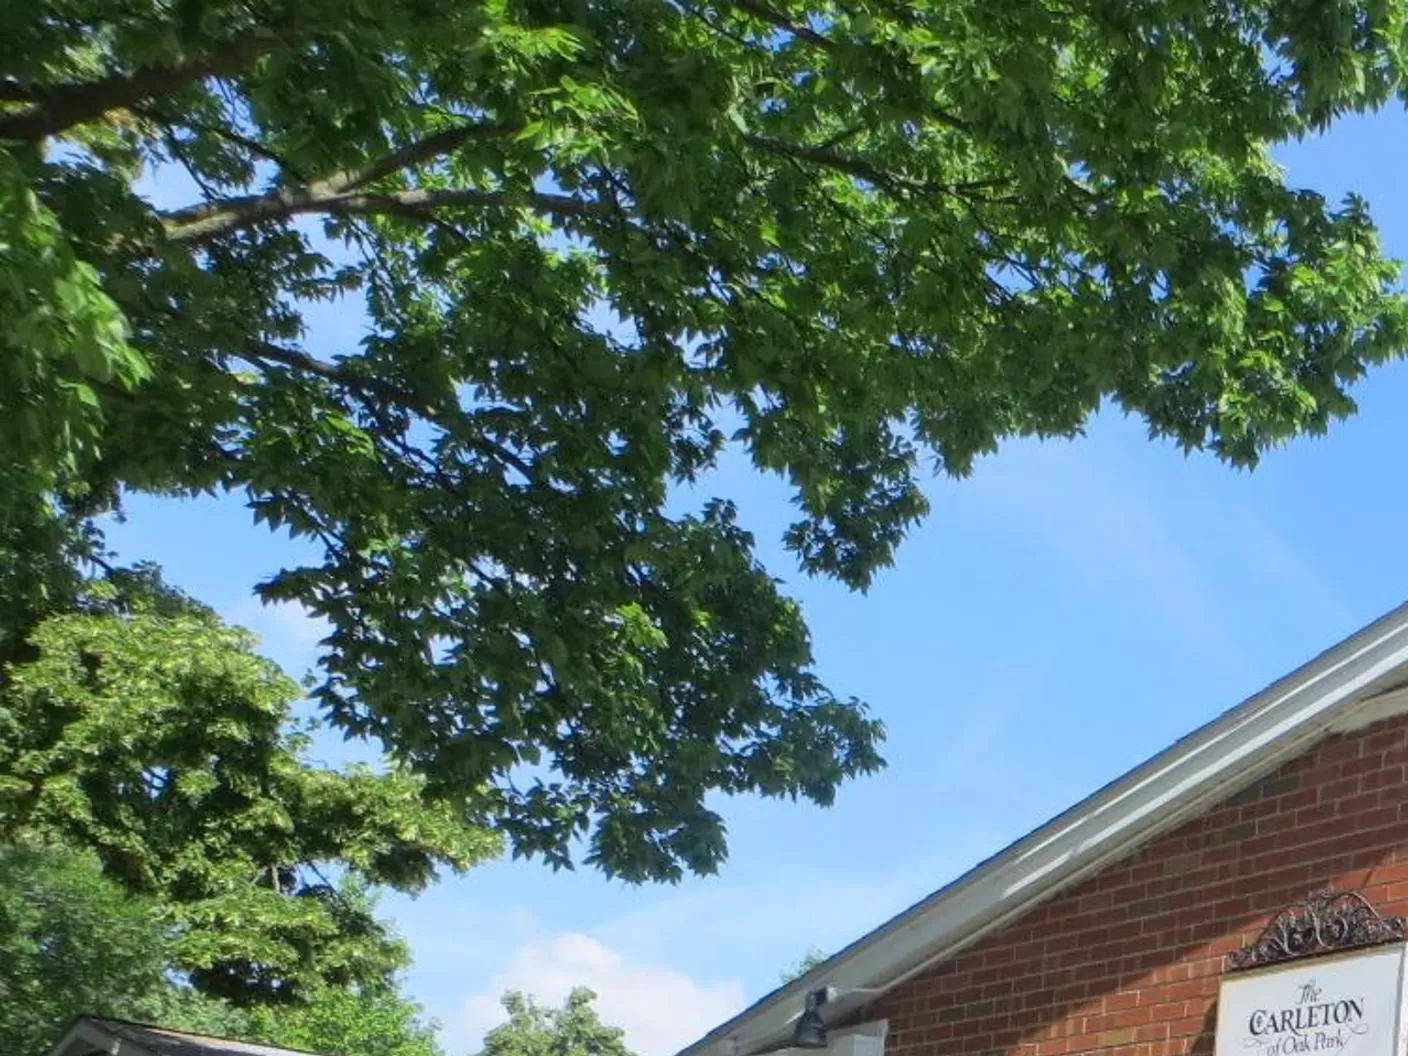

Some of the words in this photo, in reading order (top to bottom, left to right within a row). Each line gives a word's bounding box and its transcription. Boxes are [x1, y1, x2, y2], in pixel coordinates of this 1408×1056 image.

[1295, 978, 1322, 1004] The
[1249, 998, 1364, 1036] CARLETON
[1283, 1034, 1310, 1055] Oak
[1315, 1028, 1346, 1052] Park
